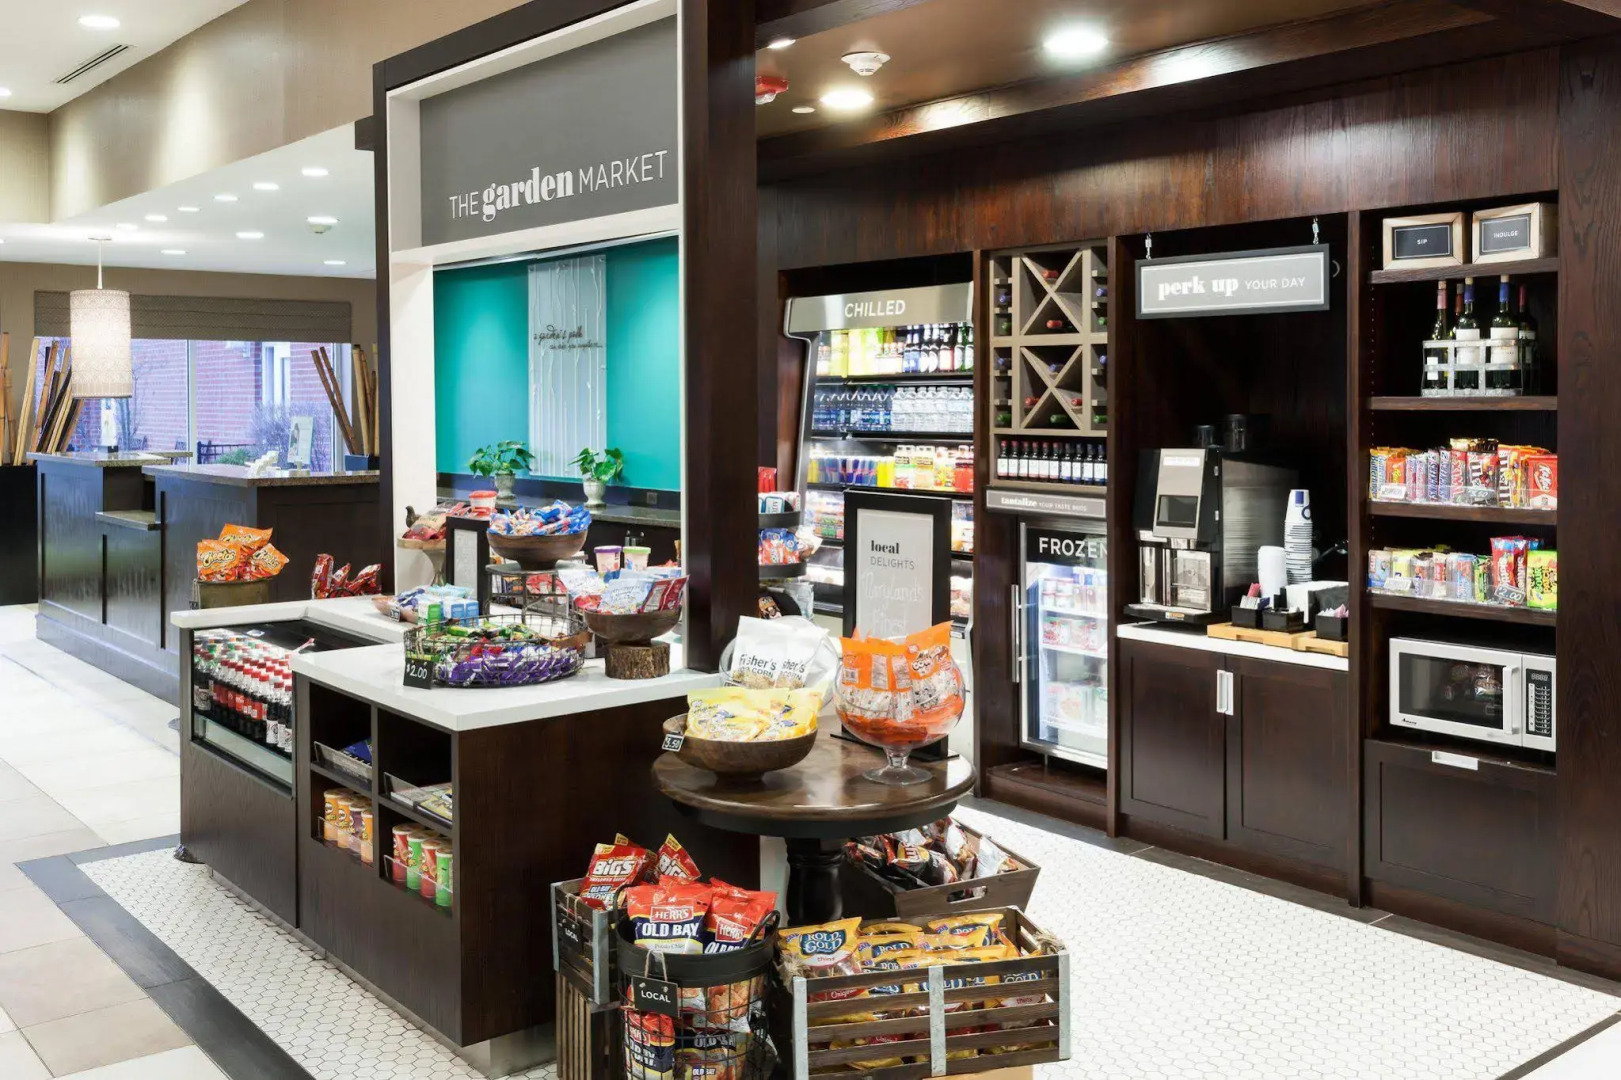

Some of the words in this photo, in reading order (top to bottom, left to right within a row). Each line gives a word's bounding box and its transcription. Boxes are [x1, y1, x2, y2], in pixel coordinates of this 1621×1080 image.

[449, 191, 479, 219] THE
[482, 167, 574, 222] garden
[579, 150, 668, 194] MARKET
[1158, 276, 1206, 301] perk
[1212, 276, 1239, 297] up
[1244, 279, 1278, 290] YOUR
[1282, 277, 1306, 288] DAY
[844, 300, 906, 318] CHILLED
[1001, 496, 1038, 507] tantalize
[870, 540, 900, 554] local
[1038, 537, 1107, 558] FROZEN
[200, 548, 236, 569] Cheetos
[870, 556, 915, 570] DELIGHTS
[739, 653, 777, 671] Fisher's
[406, 663, 428, 680] $2.00
[642, 922, 669, 937] OLD
[672, 922, 700, 937] BAY
[808, 931, 841, 942] ROLD
[805, 937, 842, 954] GOLD
[640, 990, 671, 1003] LOCAL
